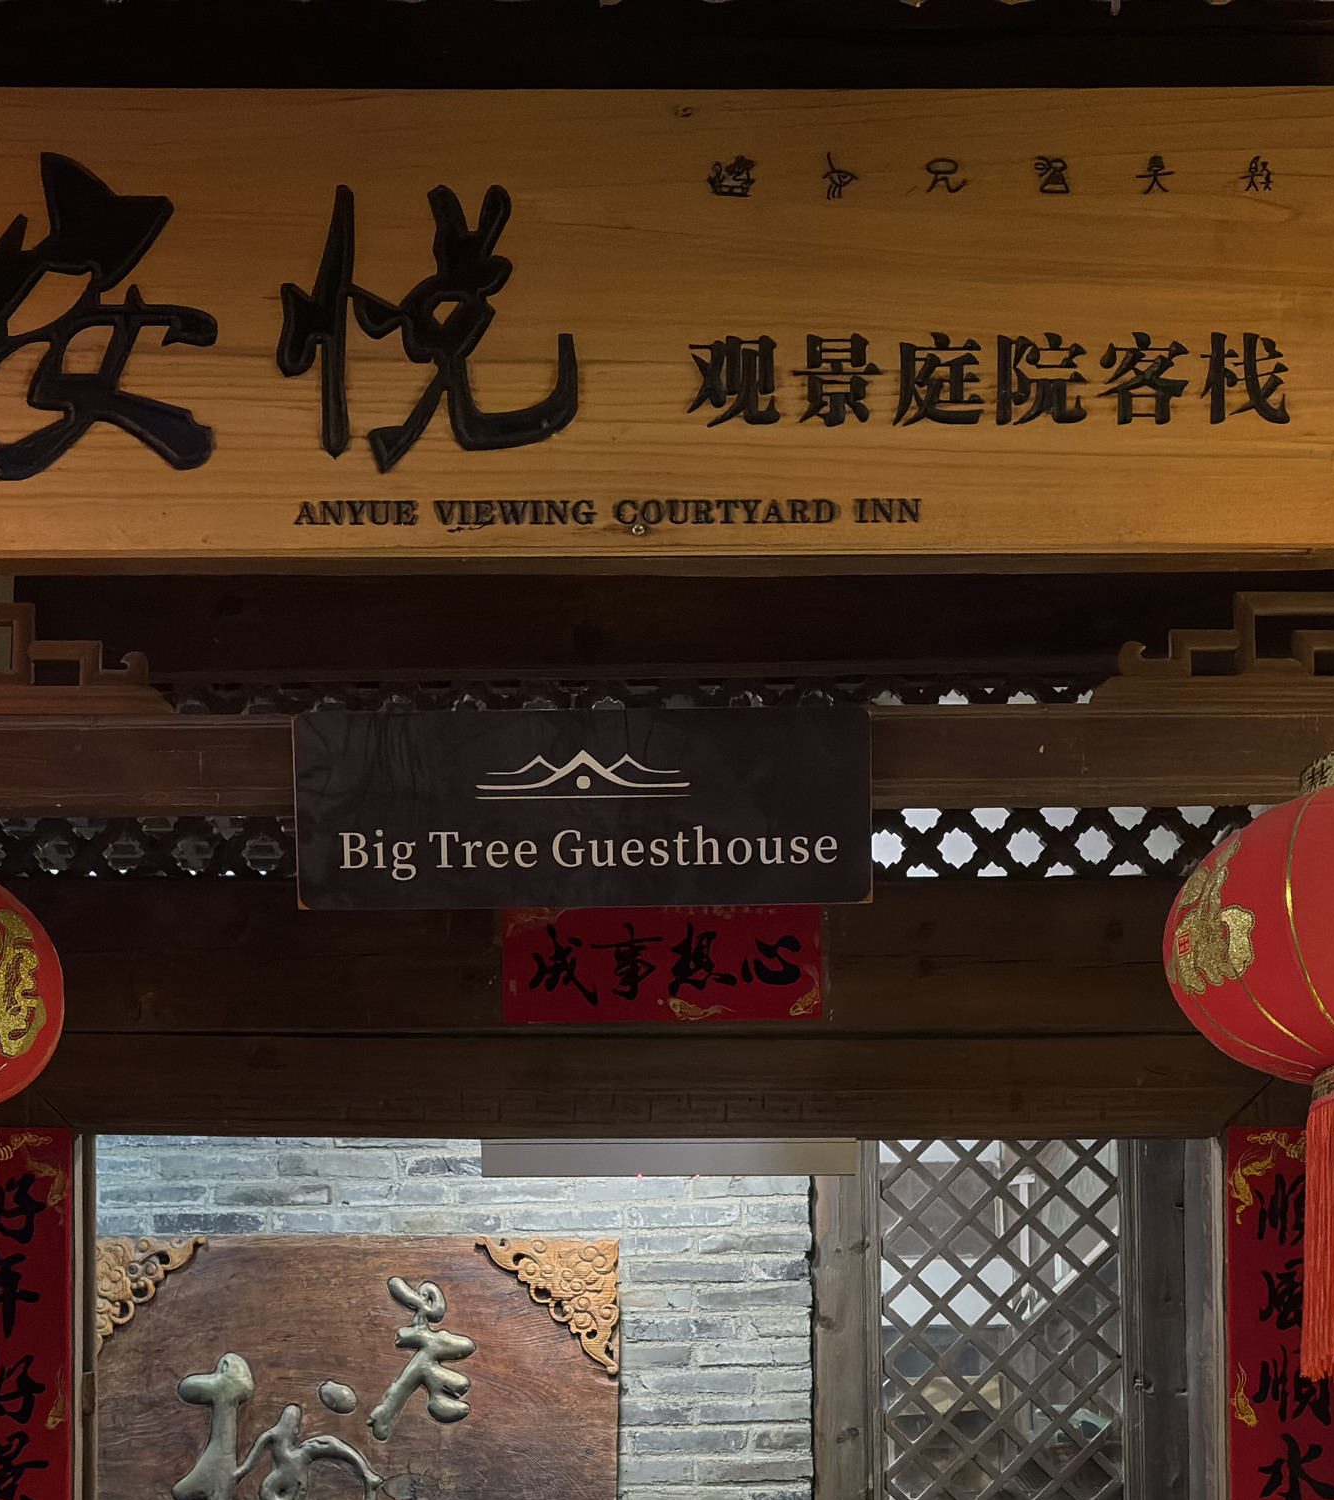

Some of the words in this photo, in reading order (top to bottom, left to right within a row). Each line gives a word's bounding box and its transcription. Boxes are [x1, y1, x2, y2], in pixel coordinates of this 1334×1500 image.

[688, 330, 1291, 433] 观景庭院客栈
[293, 499, 418, 526] ANYUE
[434, 499, 597, 526] VIEWING
[612, 498, 835, 526] COURTYARD
[854, 498, 922, 523] INN
[338, 829, 417, 881] Big
[428, 830, 538, 870] Tree
[552, 826, 839, 869] Guesthouse
